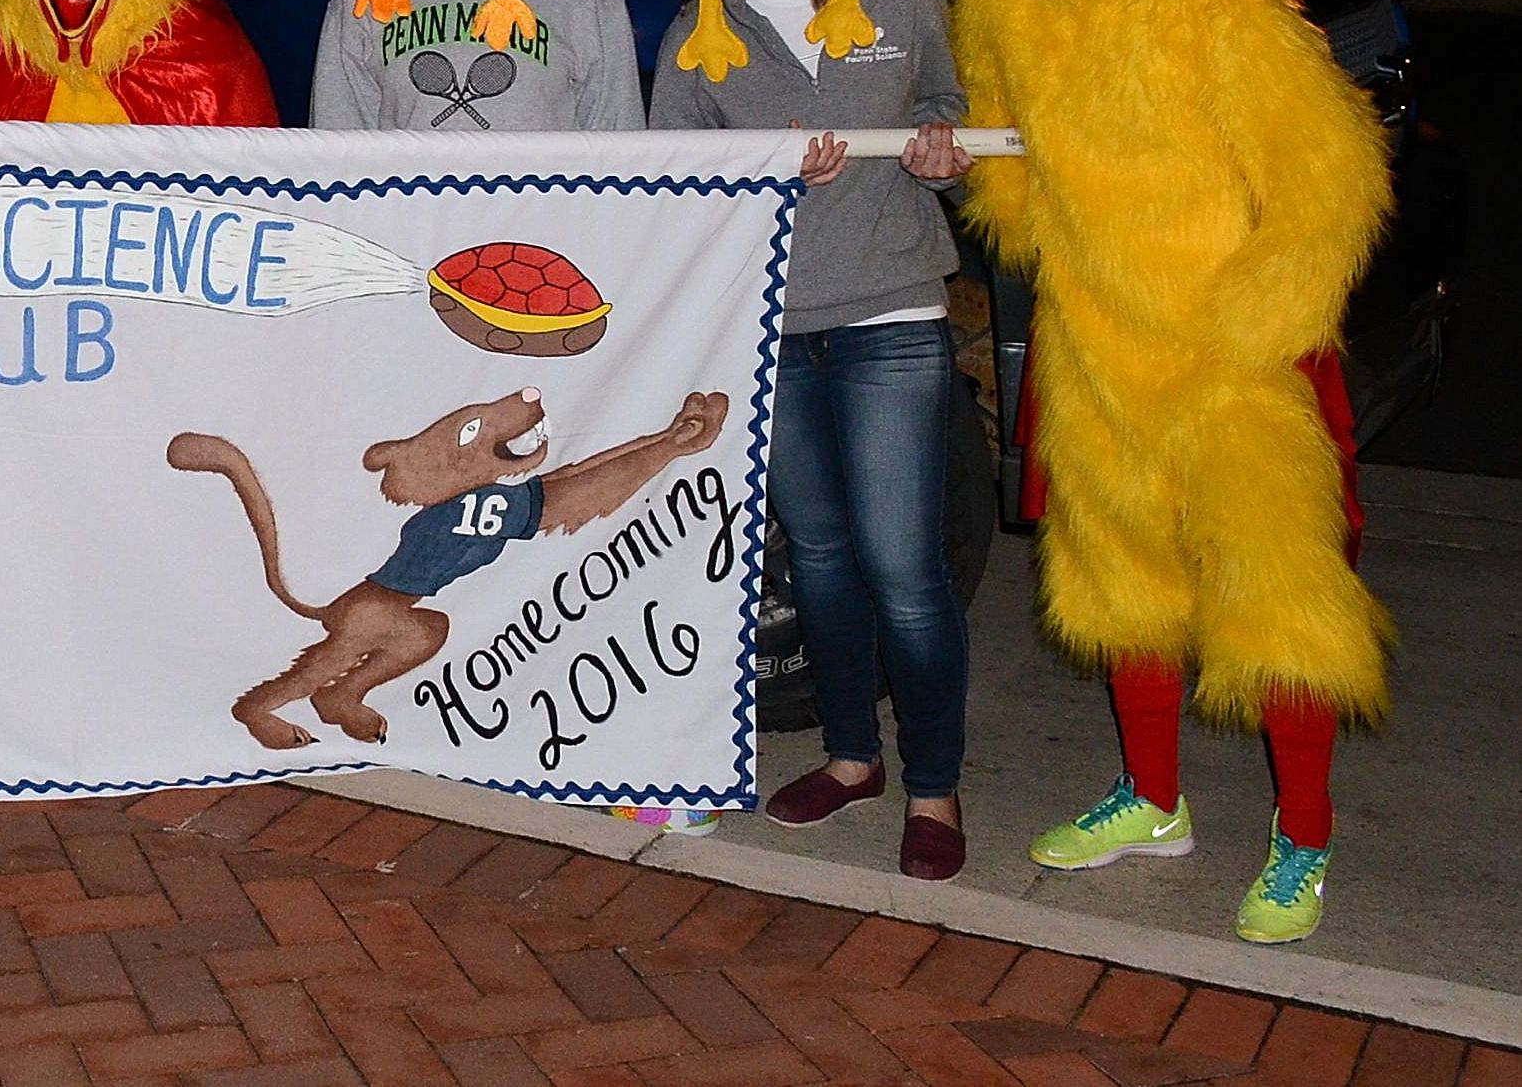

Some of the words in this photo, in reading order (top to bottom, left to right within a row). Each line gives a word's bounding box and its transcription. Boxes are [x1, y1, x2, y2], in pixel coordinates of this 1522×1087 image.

[382, 3, 449, 67] PENN
[454, 2, 549, 67] MOR
[845, 54, 874, 64] Poultry
[854, 48, 874, 56] Penn
[451, 493, 509, 536] 16
[413, 467, 743, 748] Homecoming
[530, 599, 701, 771] 2016
